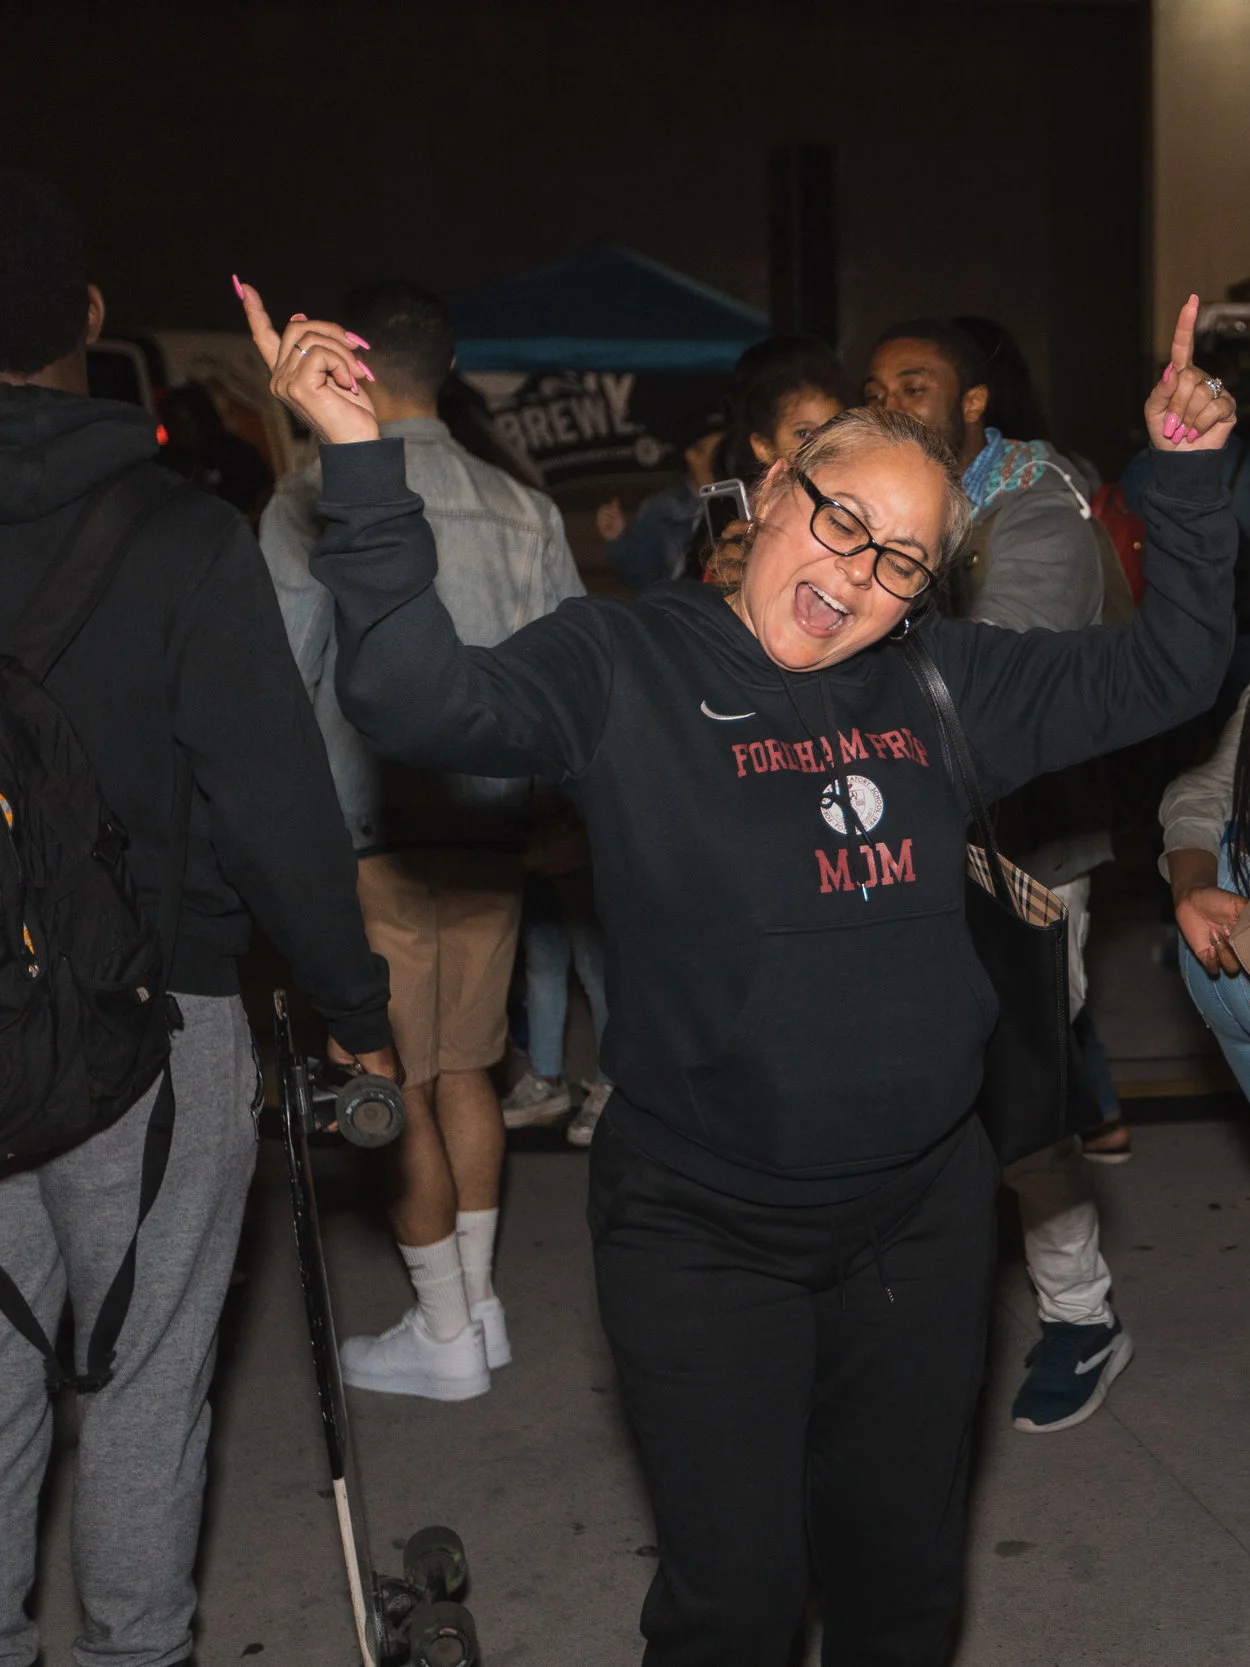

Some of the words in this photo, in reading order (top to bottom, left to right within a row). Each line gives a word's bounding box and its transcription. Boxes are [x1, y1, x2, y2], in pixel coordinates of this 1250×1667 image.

[732, 728, 869, 777] FORDHAM
[871, 787, 883, 813] SCHOOL
[815, 838, 916, 893] MOM
